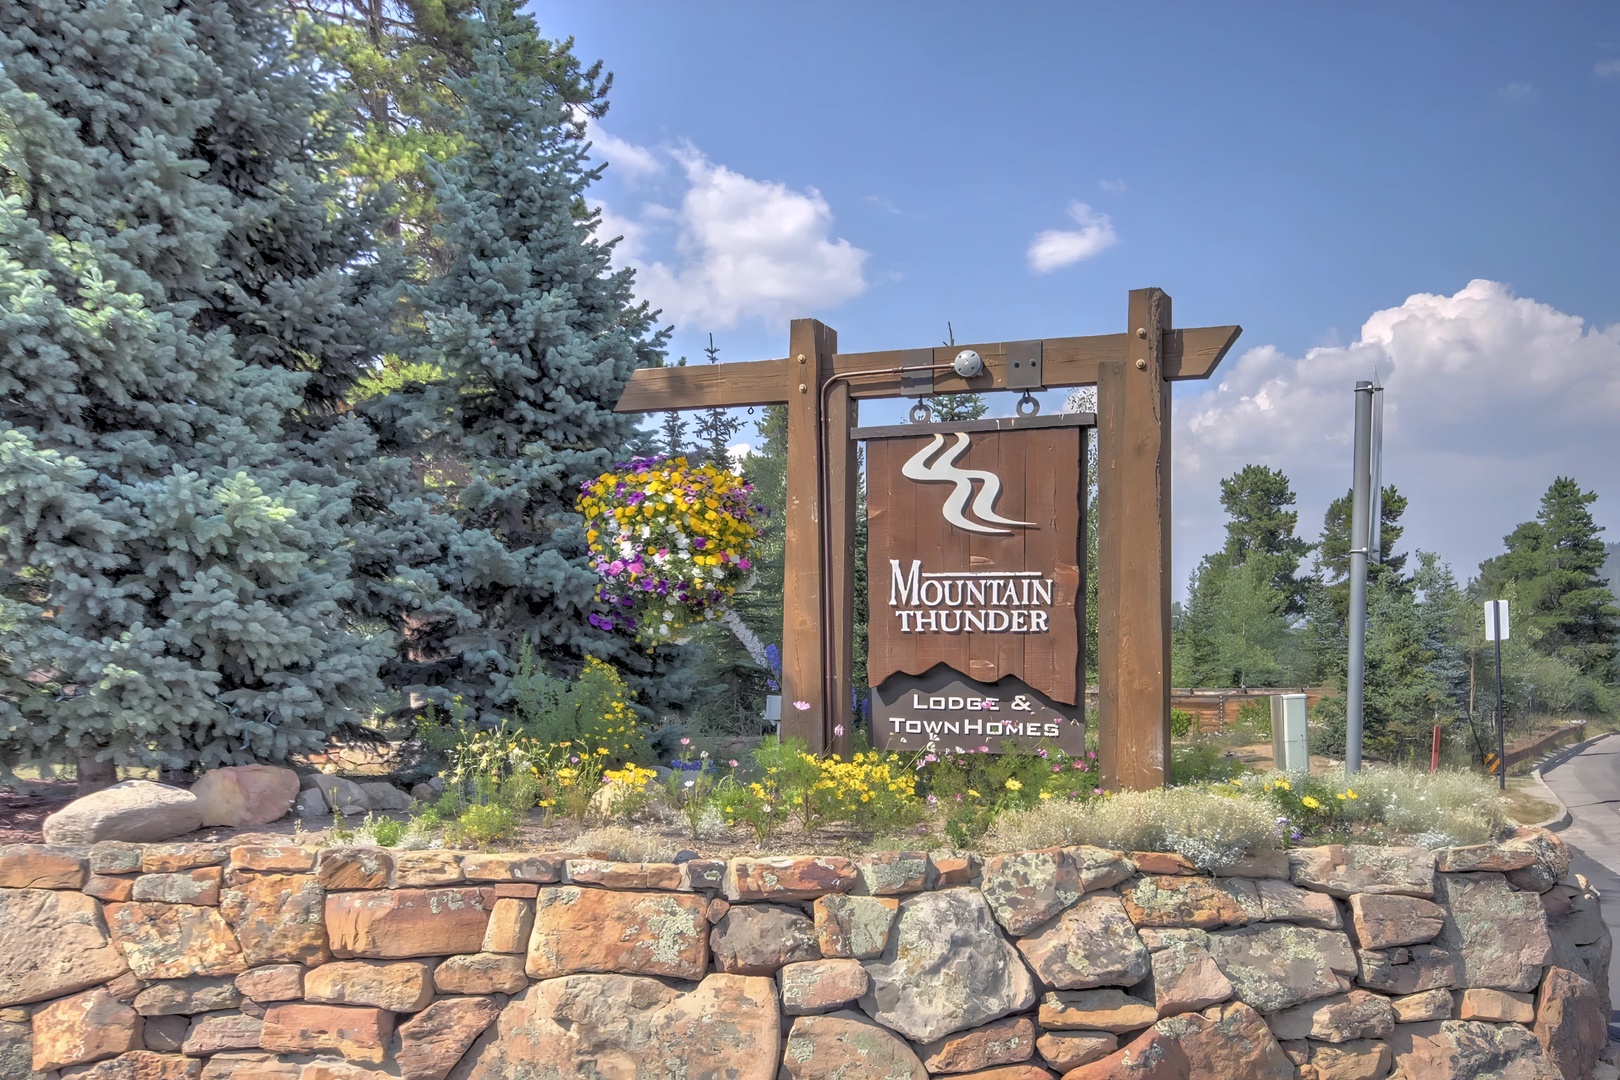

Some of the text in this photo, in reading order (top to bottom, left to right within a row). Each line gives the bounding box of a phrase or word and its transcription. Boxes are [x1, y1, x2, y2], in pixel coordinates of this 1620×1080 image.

[889, 559, 1053, 606] MOUNTAIN
[895, 610, 1049, 632] THUNDER
[913, 694, 1032, 711] LODGE &
[889, 717, 1060, 737] TOWNHOMES
